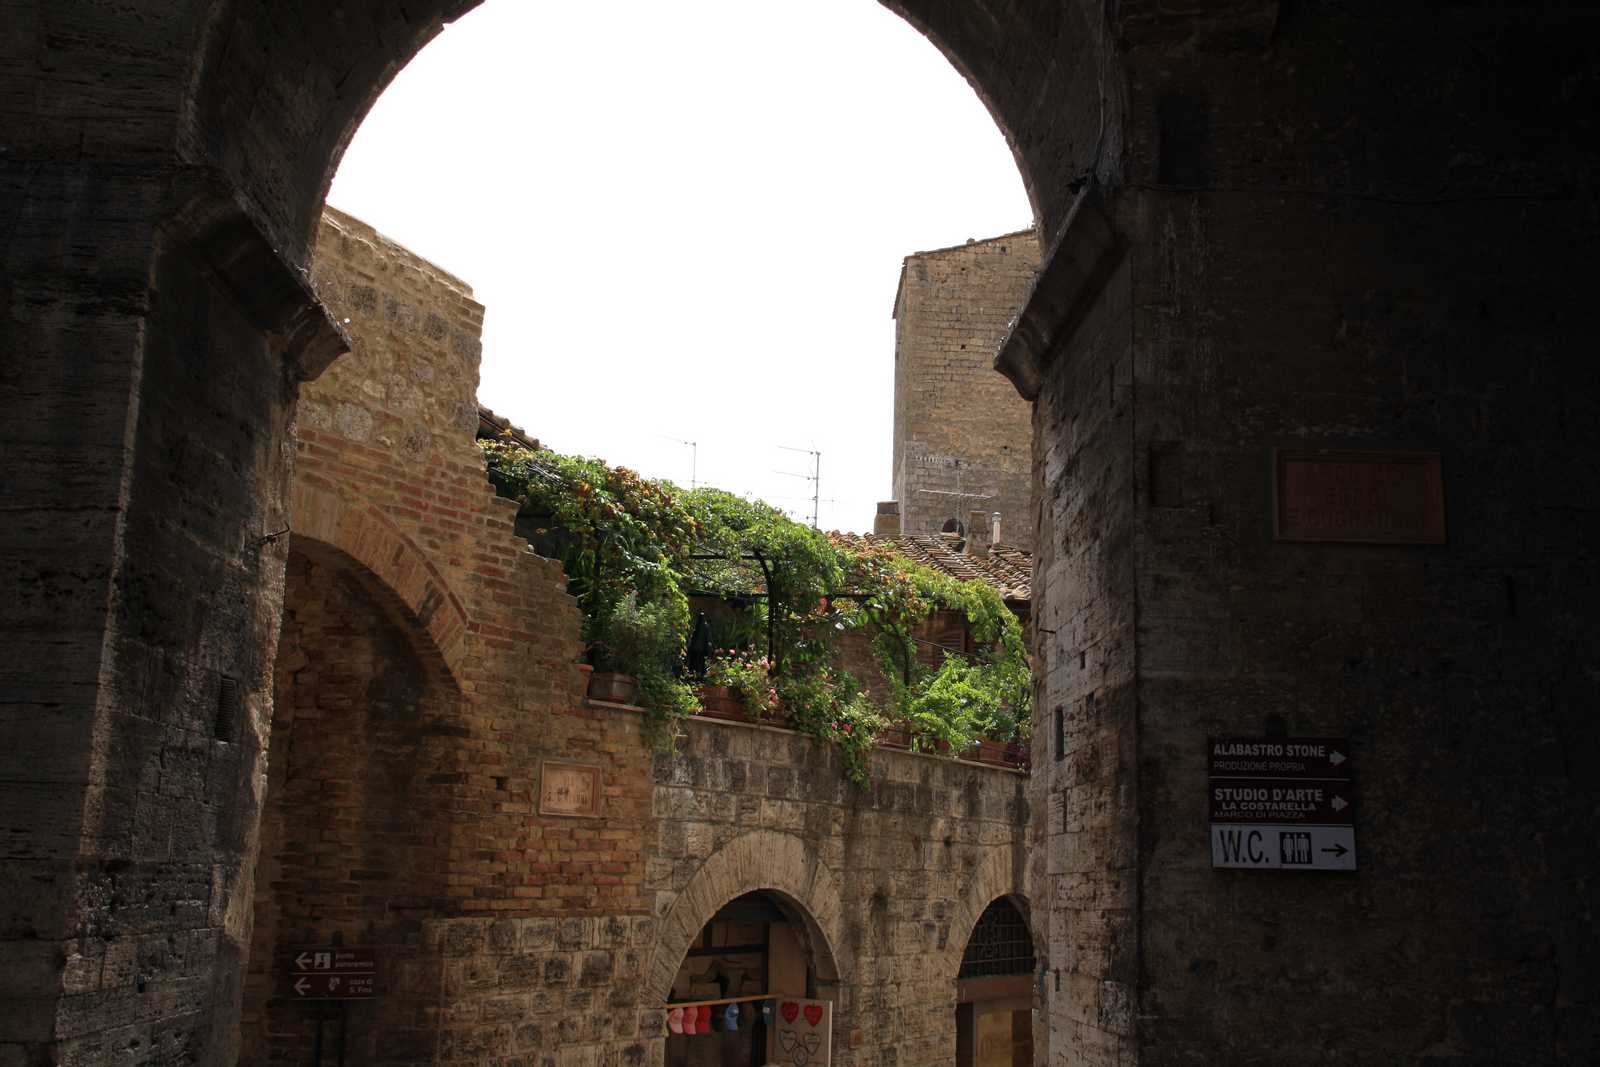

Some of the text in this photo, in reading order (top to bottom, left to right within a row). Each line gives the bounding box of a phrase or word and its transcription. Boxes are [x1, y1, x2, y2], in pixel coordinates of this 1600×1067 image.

[1213, 744, 1325, 757] ALABASTRO STONE
[1213, 760, 1267, 771] PRODUZIONE
[1214, 788, 1323, 802] STUDIO D'ARTE
[1222, 802, 1317, 811] LA COSTARELLA
[1219, 829, 1269, 863] W.C.
